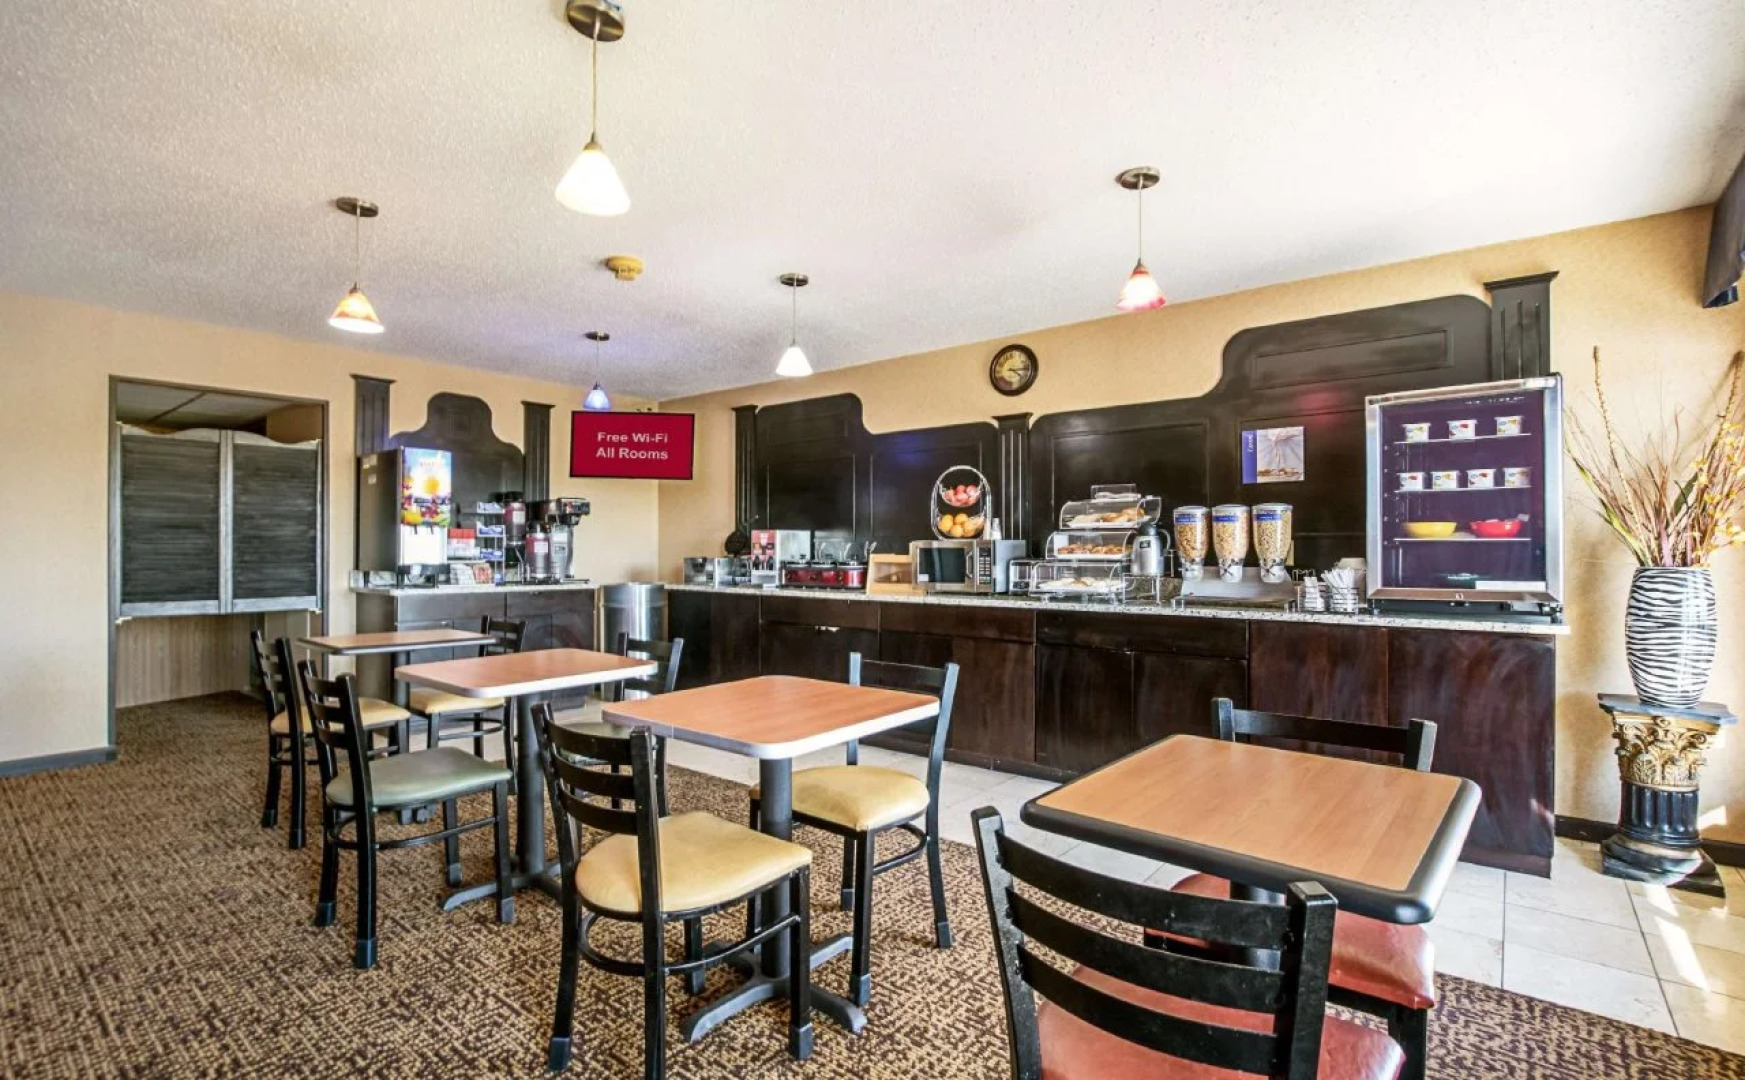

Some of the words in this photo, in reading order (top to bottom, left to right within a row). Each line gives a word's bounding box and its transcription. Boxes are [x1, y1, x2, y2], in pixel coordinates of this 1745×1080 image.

[597, 432, 628, 443] Free
[632, 433, 668, 443] Wi-Fi
[596, 447, 615, 458] All
[618, 447, 668, 460] Rooms
